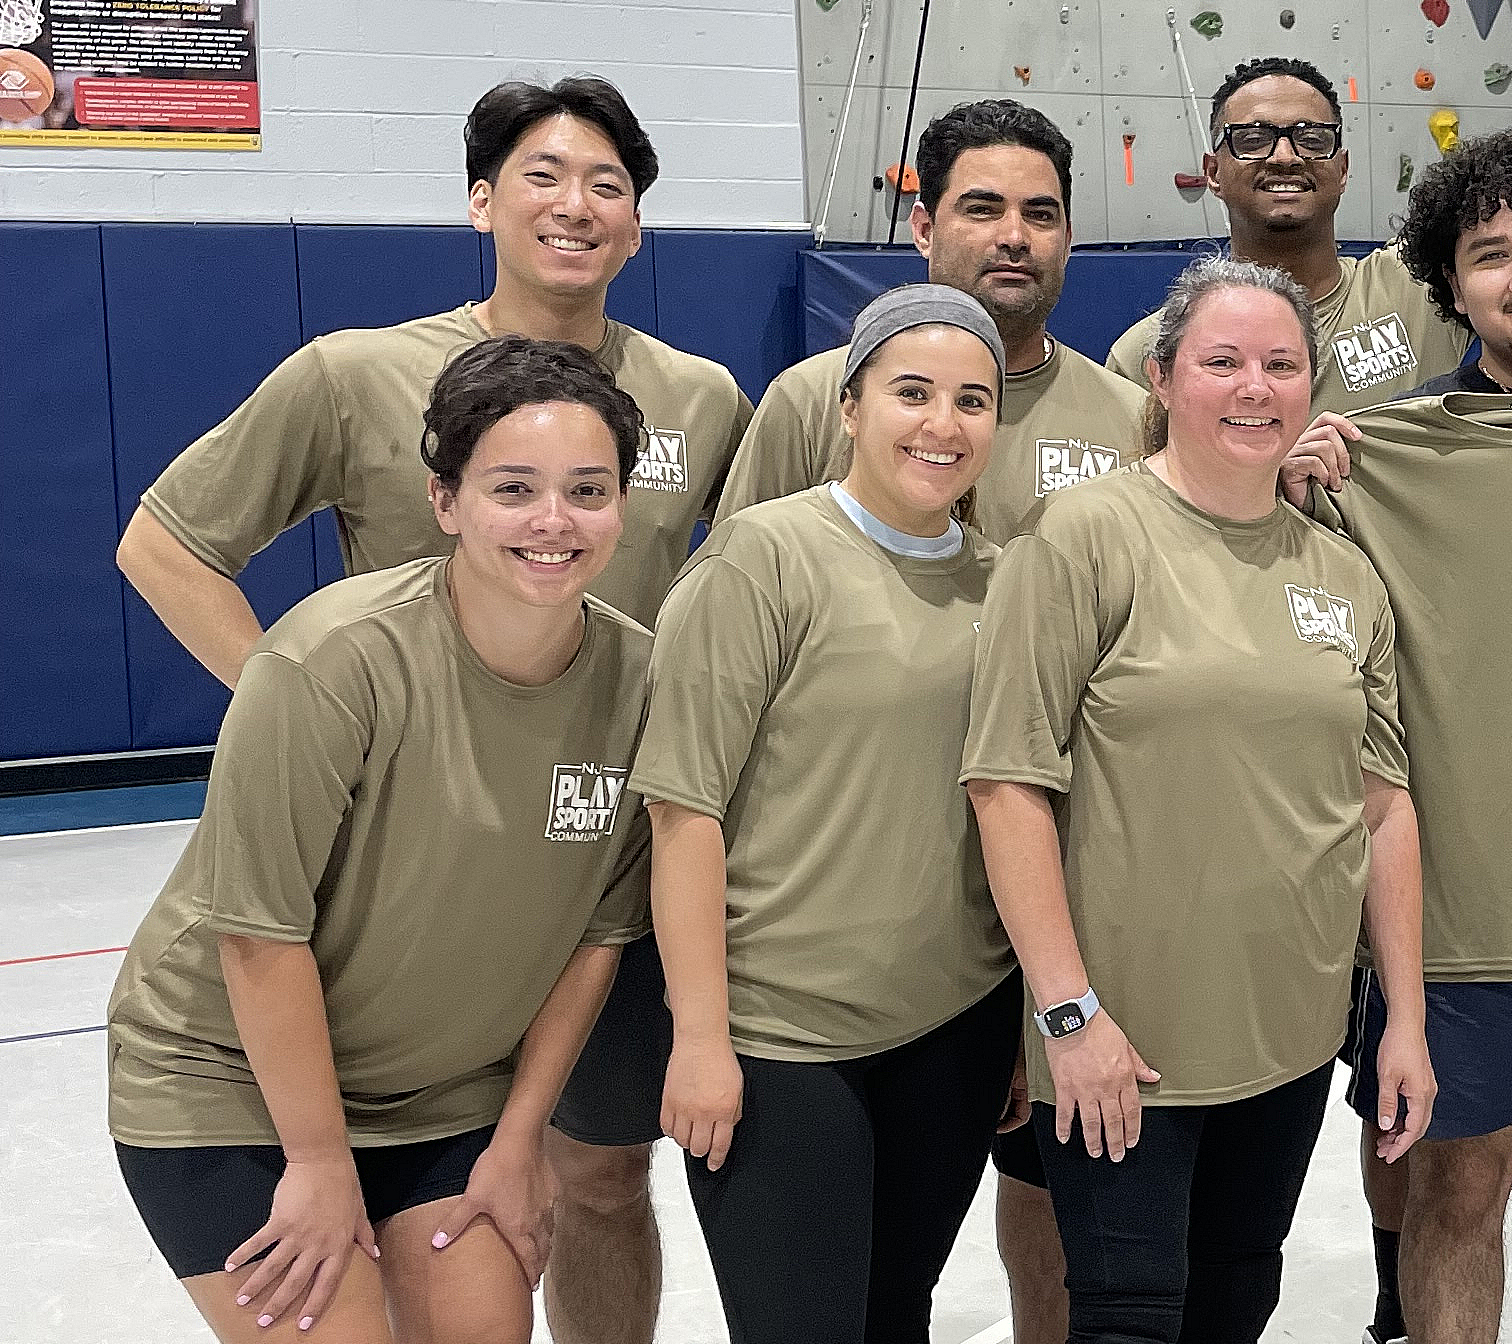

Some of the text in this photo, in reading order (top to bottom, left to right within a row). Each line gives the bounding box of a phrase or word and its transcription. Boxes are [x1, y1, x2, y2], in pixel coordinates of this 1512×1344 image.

[1353, 320, 1372, 334] NJ
[1336, 320, 1401, 367] PLAY
[1345, 344, 1410, 383] SPORTS
[1352, 363, 1412, 392] COMMUNITY
[1068, 438, 1089, 451] NJ
[1041, 446, 1115, 478] PLAY
[626, 478, 684, 493] OMMUNITY
[581, 762, 604, 775] NJ
[556, 774, 626, 809] PLAY
[553, 807, 612, 831] SPORT
